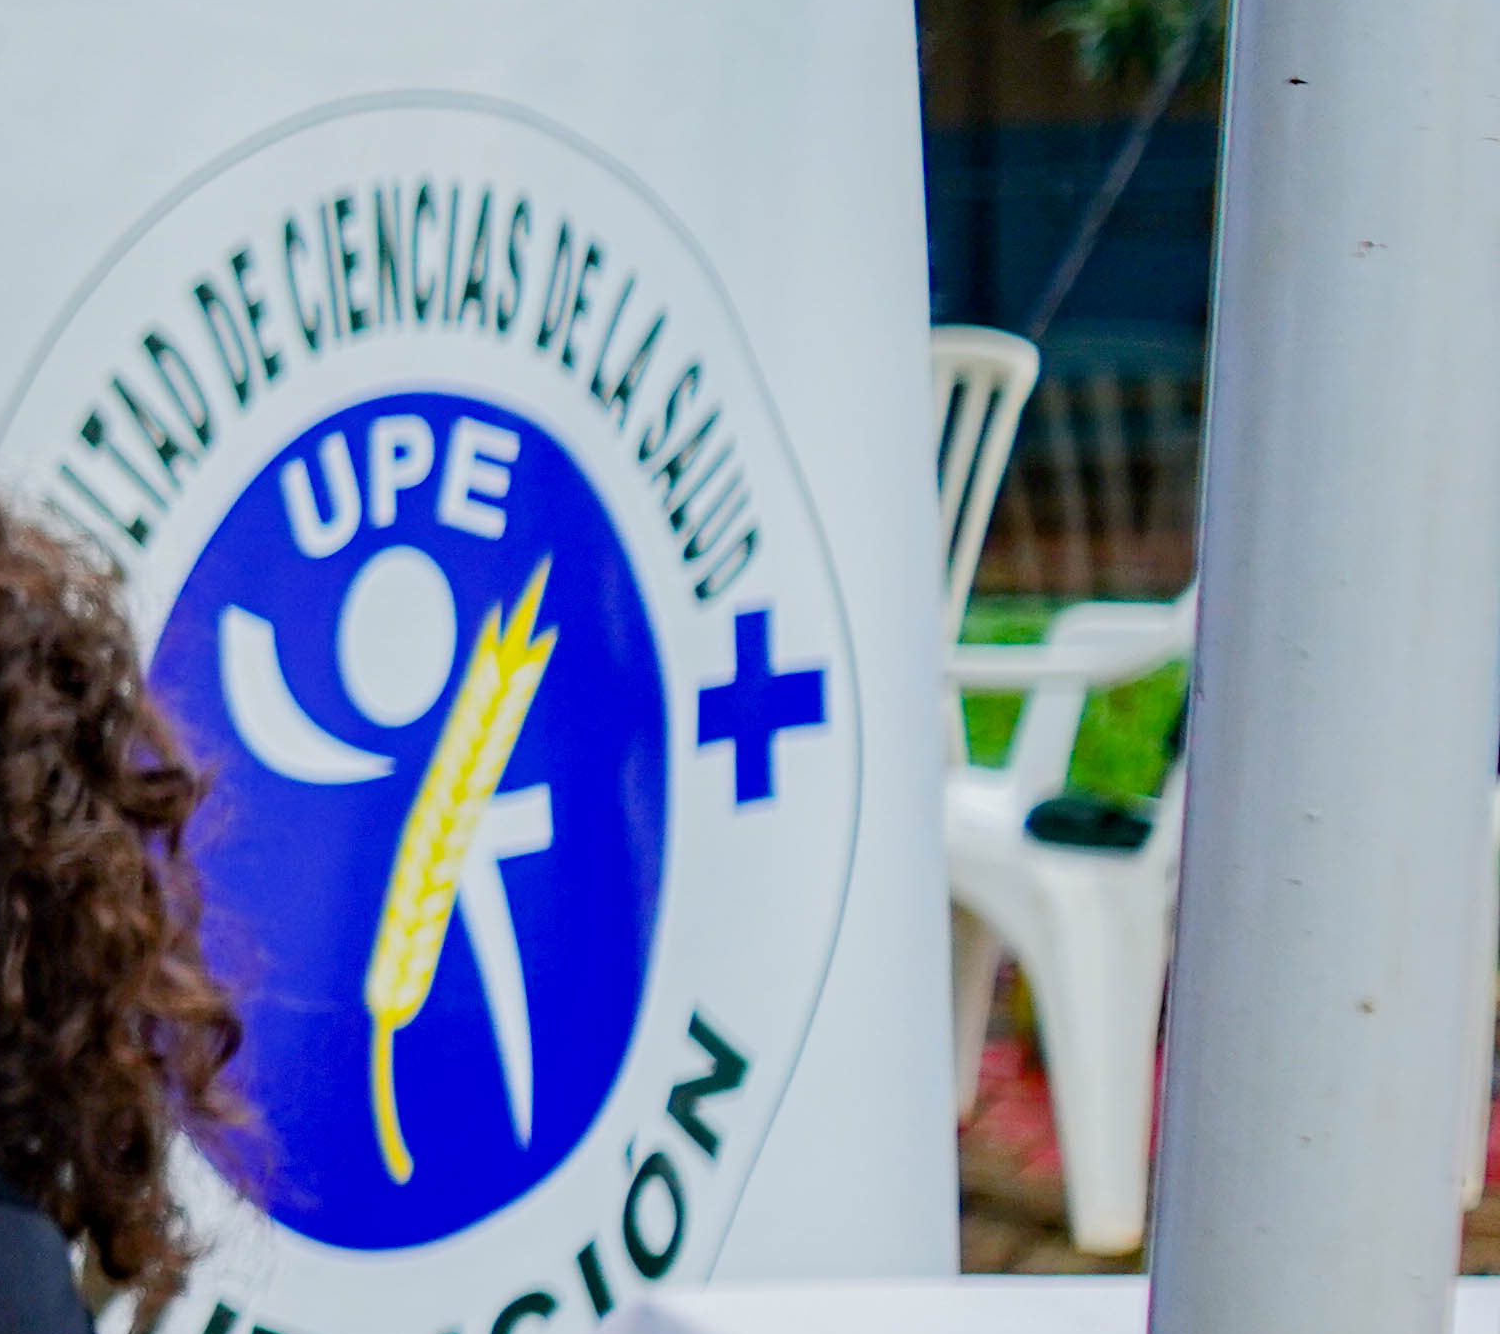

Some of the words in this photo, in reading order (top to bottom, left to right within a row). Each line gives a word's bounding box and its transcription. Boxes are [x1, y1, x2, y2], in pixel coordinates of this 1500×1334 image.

[193, 248, 285, 409] DE
[283, 178, 533, 353] CIENCIAS
[536, 219, 604, 368] DE
[589, 274, 668, 428] LA
[637, 362, 761, 602] SALUD
[278, 412, 522, 560] UPE
